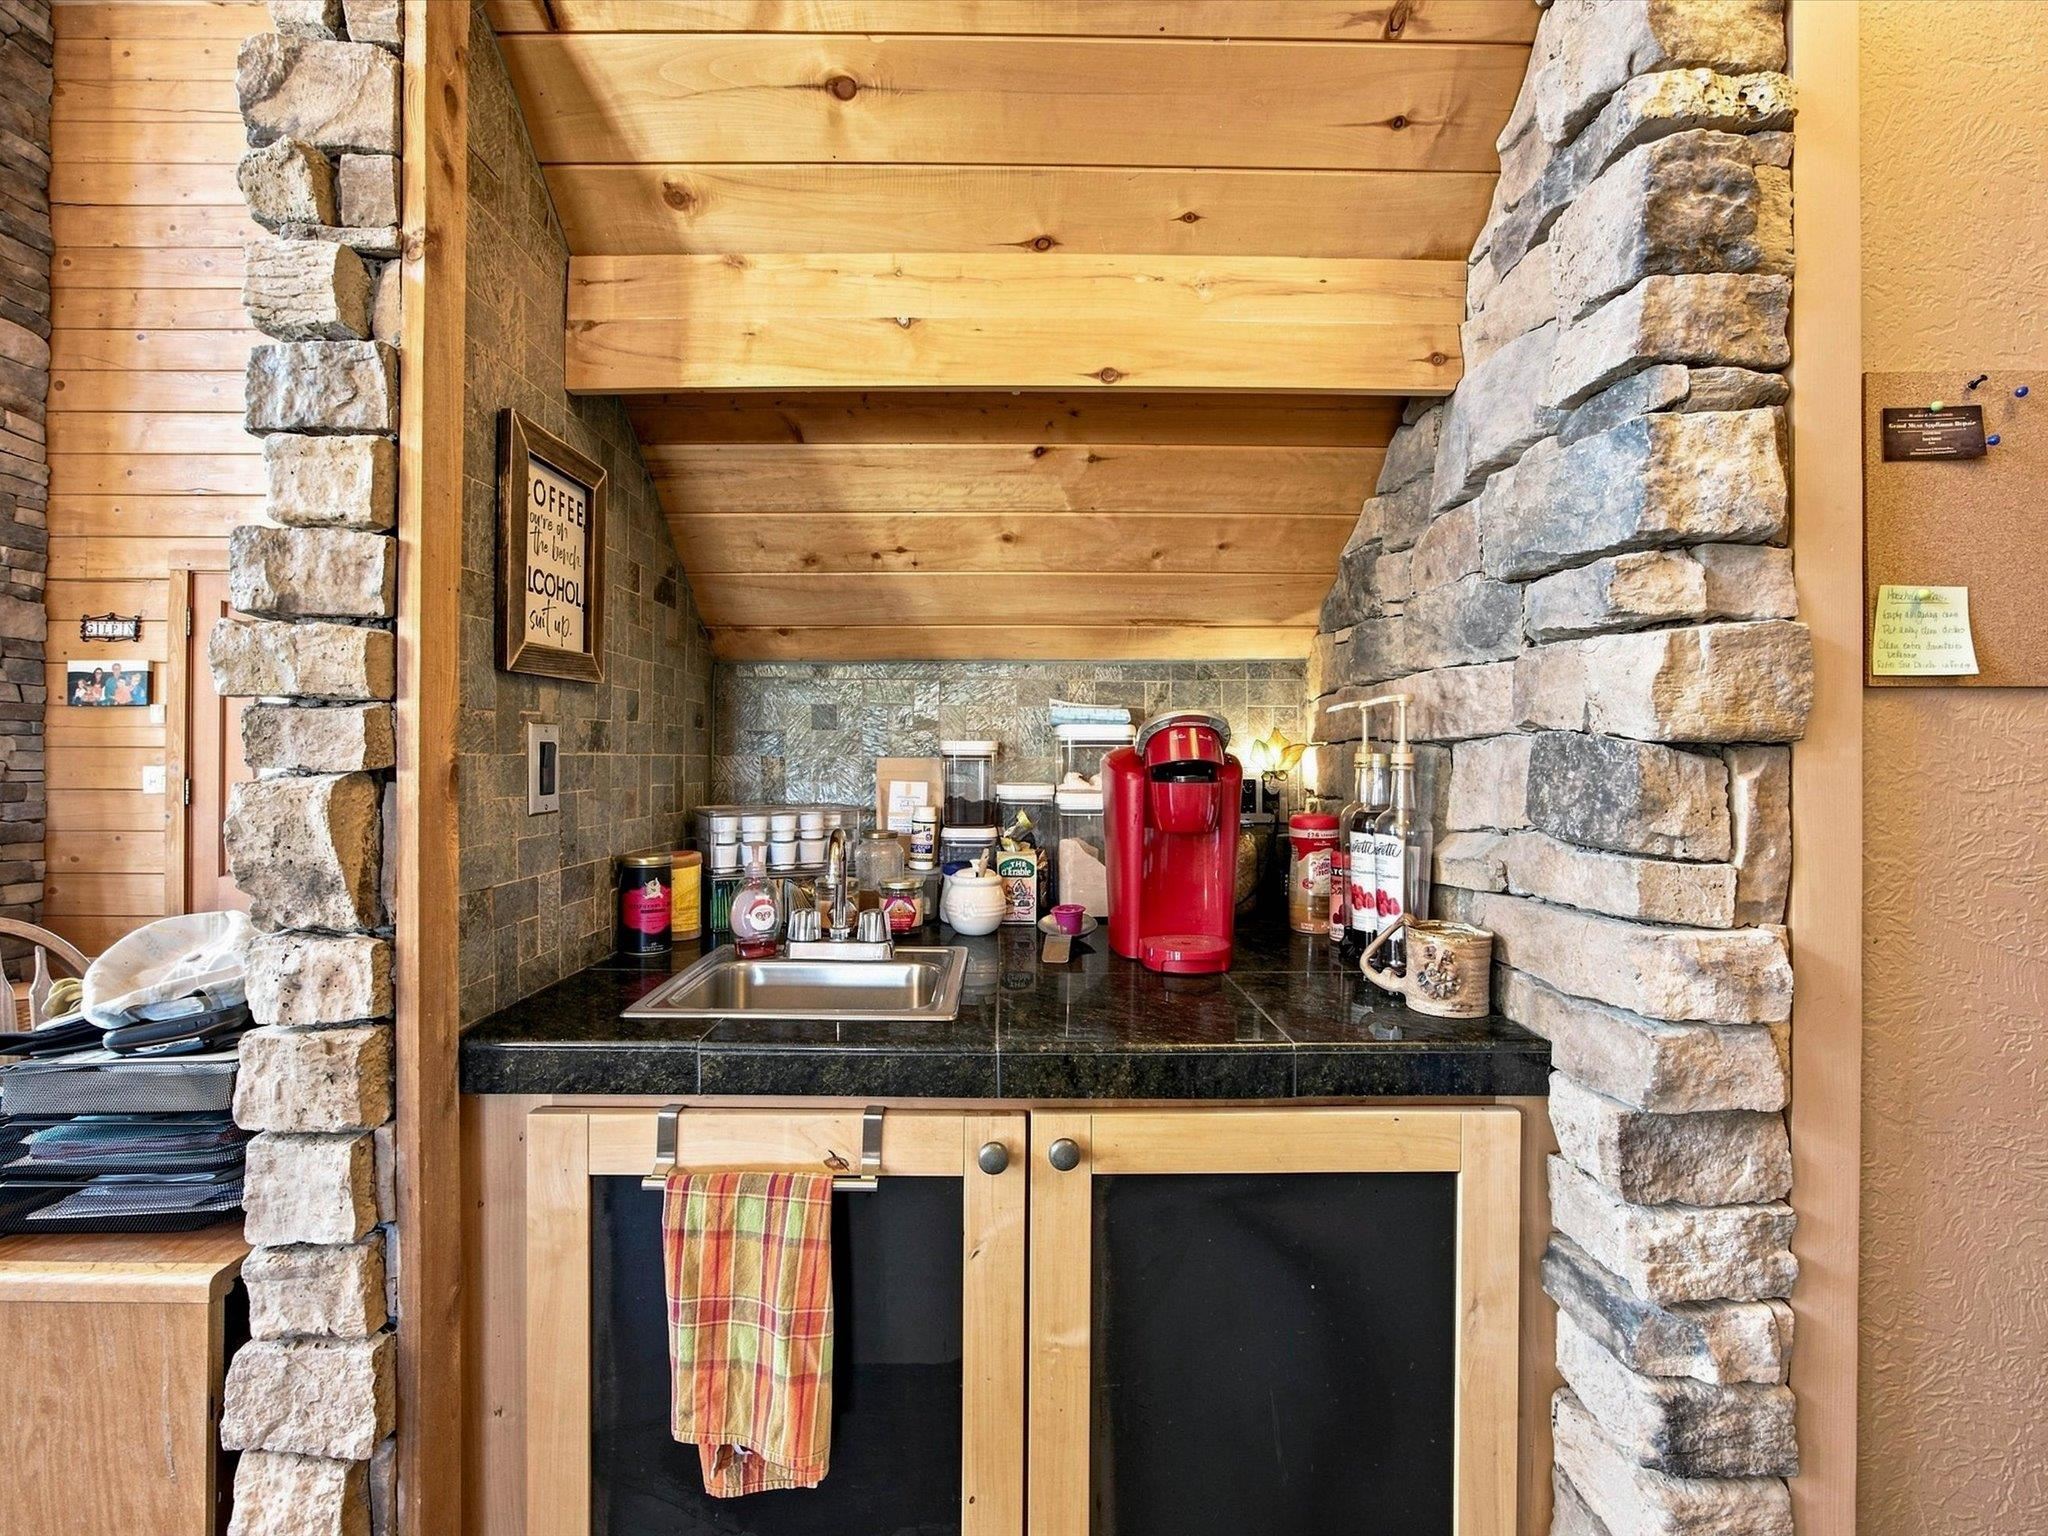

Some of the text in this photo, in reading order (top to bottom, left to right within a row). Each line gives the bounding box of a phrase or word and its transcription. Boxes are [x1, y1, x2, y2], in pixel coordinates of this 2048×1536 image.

[529, 526, 582, 571] the bench
[529, 599, 557, 638] suit
